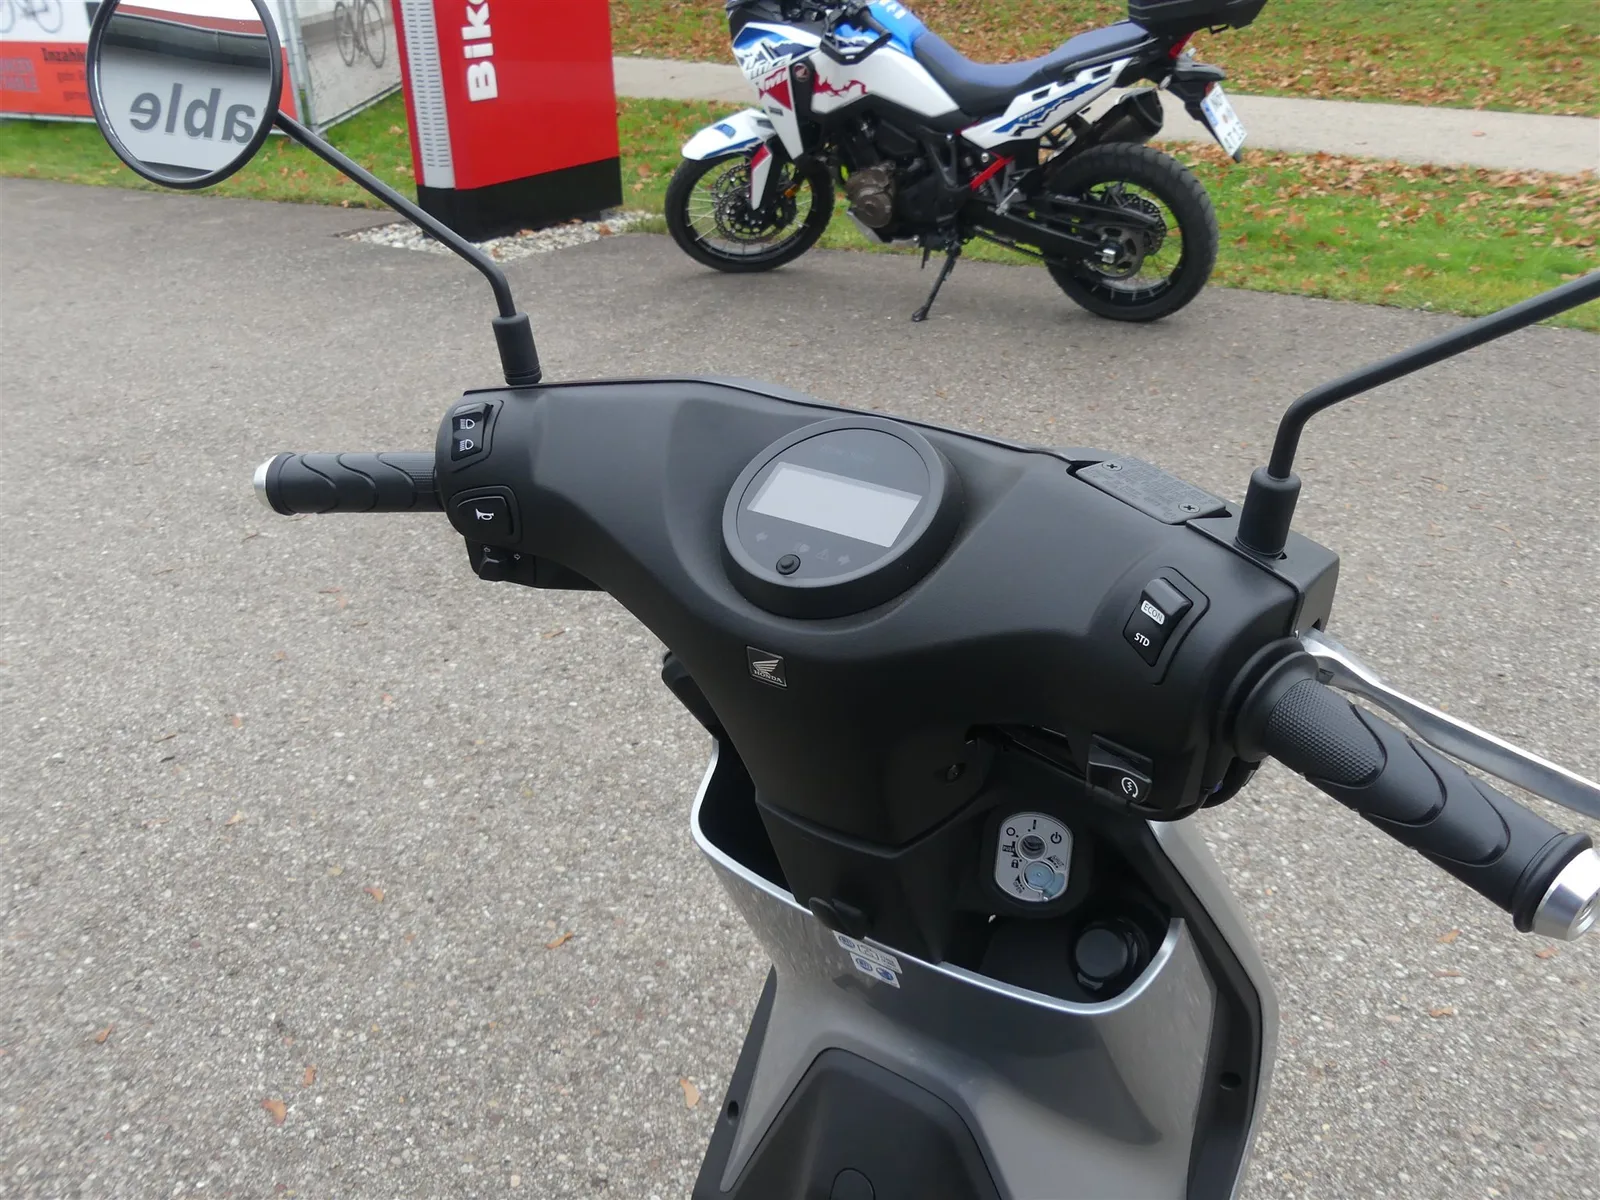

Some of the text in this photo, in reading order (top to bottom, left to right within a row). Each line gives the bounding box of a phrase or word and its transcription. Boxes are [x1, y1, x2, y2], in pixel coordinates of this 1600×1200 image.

[461, 0, 498, 102] Bik
[1143, 603, 1163, 622] ECON
[1133, 632, 1150, 647] STD
[753, 669, 784, 684] HONDA
